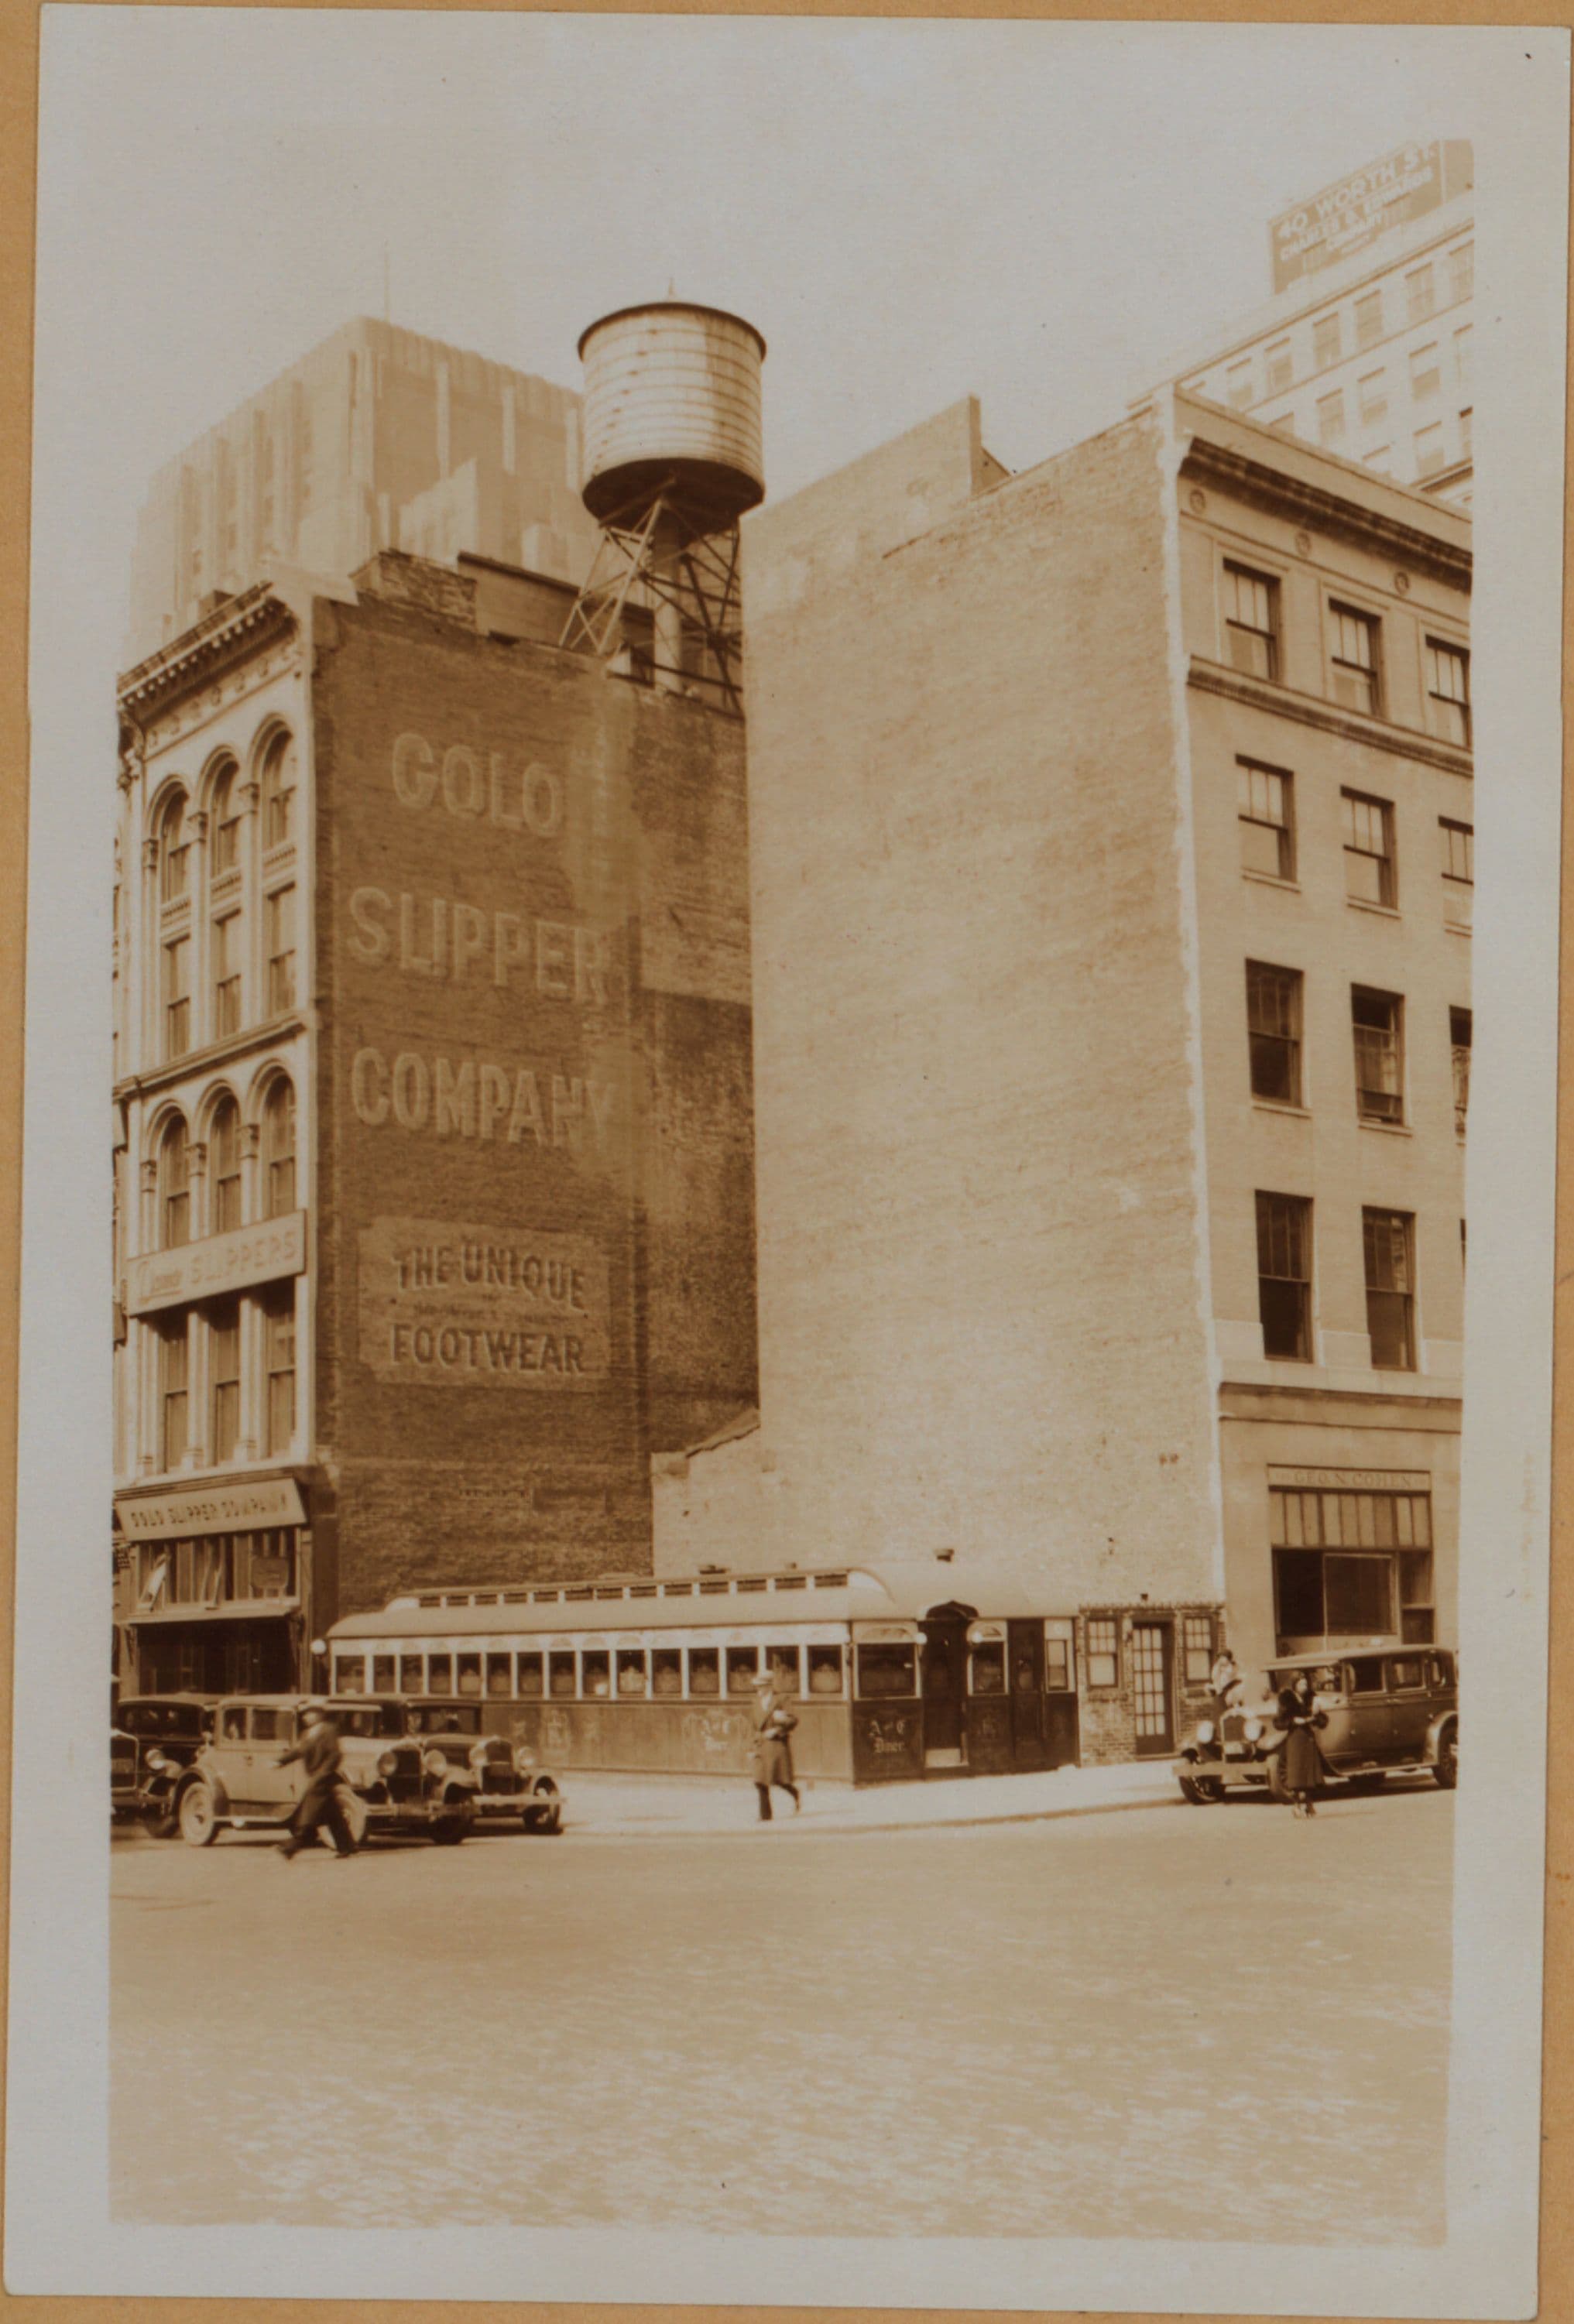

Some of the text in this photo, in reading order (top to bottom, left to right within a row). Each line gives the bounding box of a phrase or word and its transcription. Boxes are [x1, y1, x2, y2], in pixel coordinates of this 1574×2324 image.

[1314, 159, 1396, 218] WORTH
[393, 733, 560, 837] GOLO
[347, 886, 606, 1005] SLIPPER
[351, 1047, 614, 1147] COMPANY
[391, 1245, 586, 1313] THE UNIQUE
[390, 1324, 585, 1376] FOOTWEAR
[167, 1501, 218, 1525] SLIPPER
